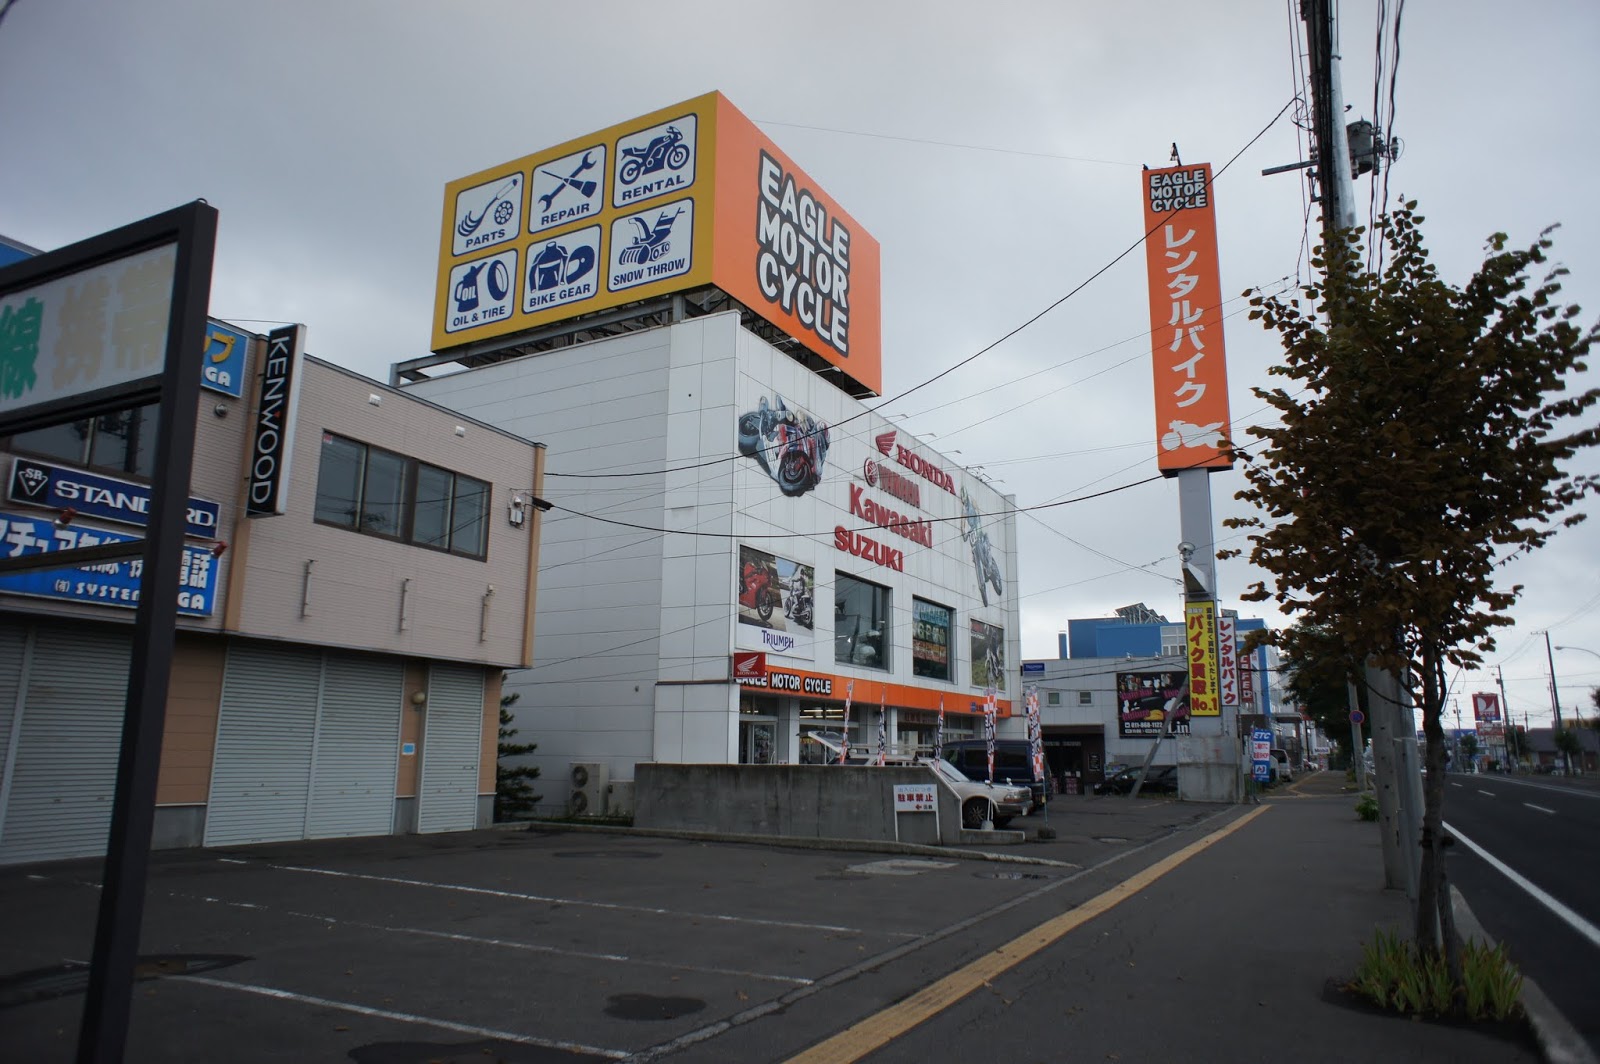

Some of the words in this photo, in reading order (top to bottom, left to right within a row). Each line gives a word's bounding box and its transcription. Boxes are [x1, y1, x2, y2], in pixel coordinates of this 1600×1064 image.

[622, 175, 685, 201] RENTAL
[1150, 169, 1205, 187] EAGLE
[1151, 182, 1206, 200] MOTOR
[541, 203, 590, 226] REPAIR
[761, 155, 848, 269] EAGLE
[1151, 195, 1207, 212] CYCLE
[466, 228, 506, 248] PARTS
[759, 200, 847, 308] MOTOR
[613, 268, 644, 286] SNOW
[647, 258, 685, 277] THROW
[461, 285, 477, 302] OIL
[529, 292, 556, 307] BIKE
[559, 283, 591, 300] GEAR
[759, 252, 847, 353] CYCLE
[453, 315, 469, 327] OIL
[471, 312, 479, 322] &
[481, 305, 506, 320] TIRE
[1165, 224, 1207, 408] レンタルバイク
[204, 330, 236, 363] プ
[203, 366, 230, 387] GA
[252, 336, 290, 504] KENWOOD
[25, 467, 42, 481] SR
[896, 443, 957, 496] HONDA
[54, 480, 214, 527] STAND
[849, 482, 932, 549] Kawasaki
[834, 525, 903, 573] SUZUKI
[761, 629, 794, 652] TRIUMPH
[1219, 620, 1236, 704] レンタルバイク
[771, 673, 800, 690] MOTOR
[804, 678, 832, 694] CYCLE
[1191, 697, 1218, 711] No.1
[1254, 731, 1271, 740] ETC
[897, 793, 934, 802] 駐車禁止
